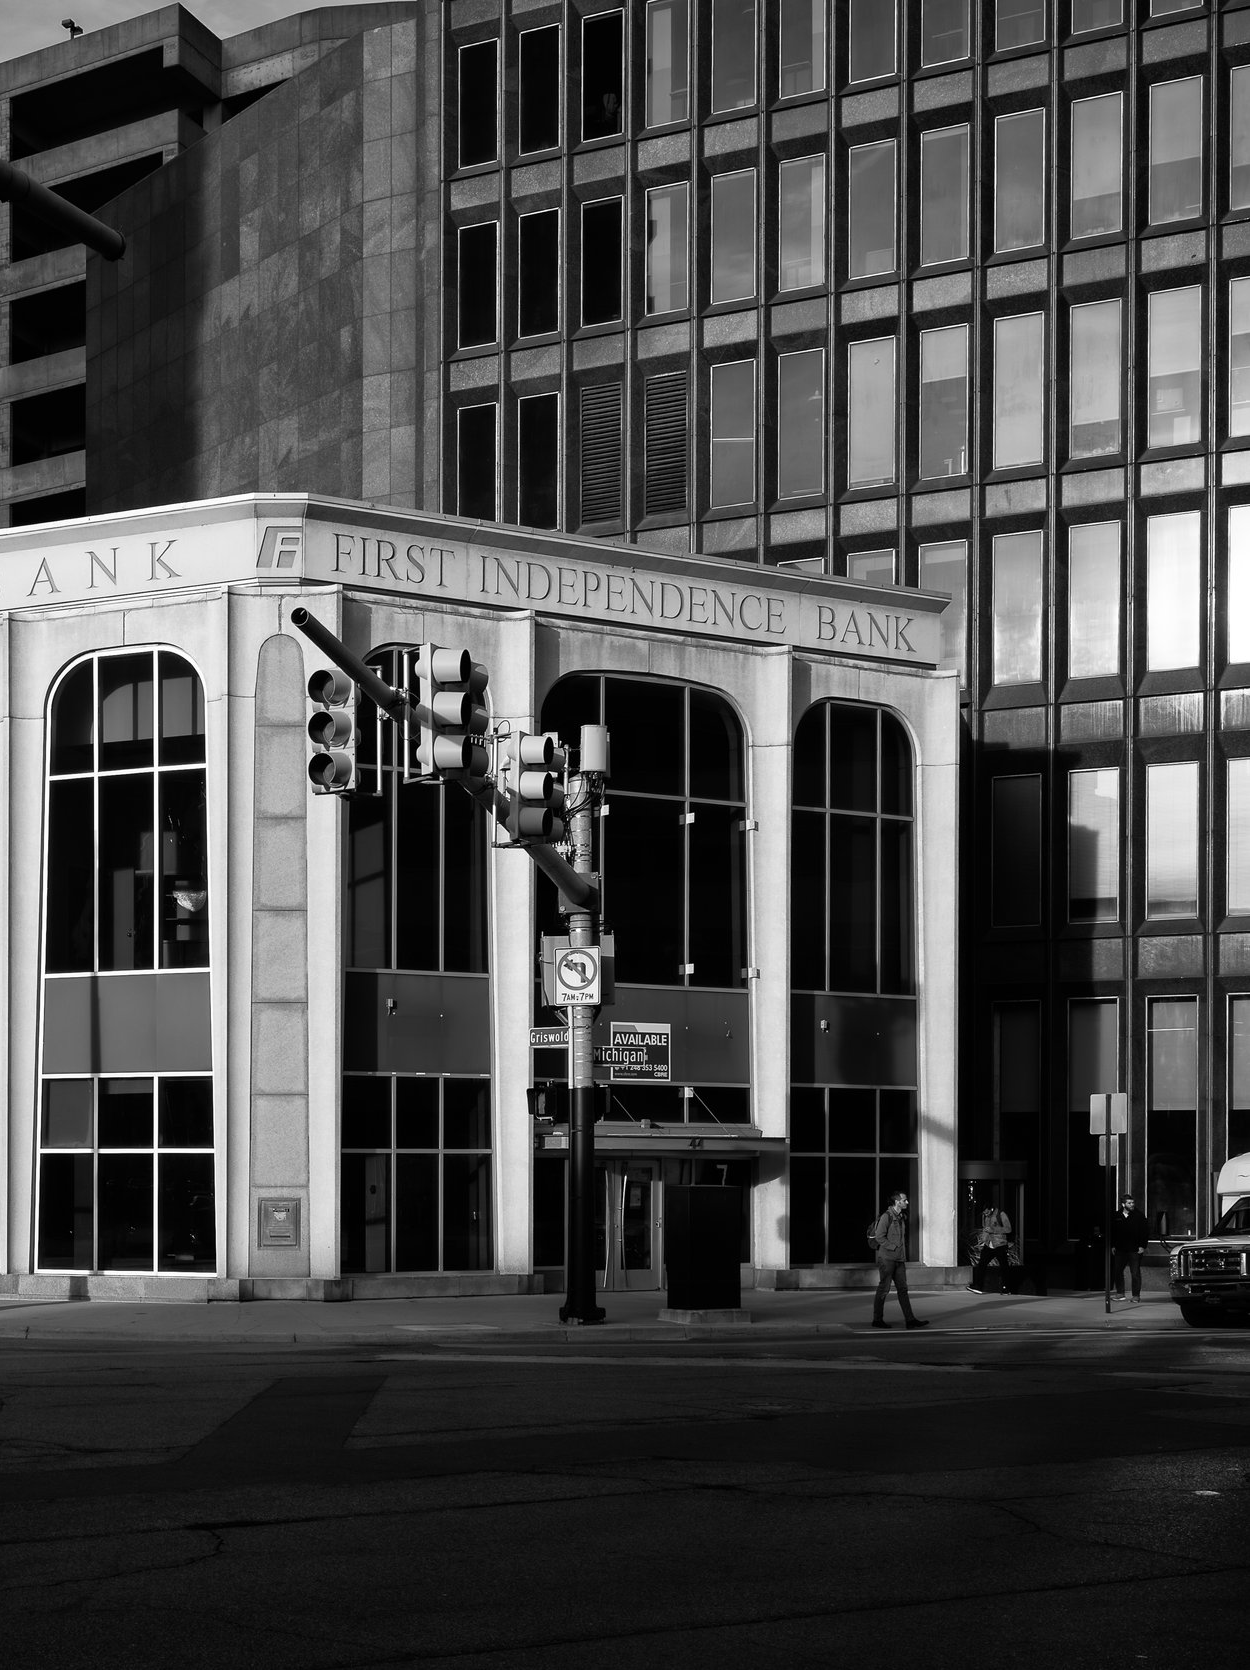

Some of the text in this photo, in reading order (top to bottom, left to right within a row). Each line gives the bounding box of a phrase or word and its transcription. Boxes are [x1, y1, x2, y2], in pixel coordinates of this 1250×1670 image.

[330, 532, 917, 652] FIRST INDEPENDENCE BANK
[530, 1031, 569, 1043] Griswold
[614, 1033, 668, 1046] AVAILABLE
[594, 1048, 643, 1065] Michigan
[653, 1064, 668, 1072] 5400
